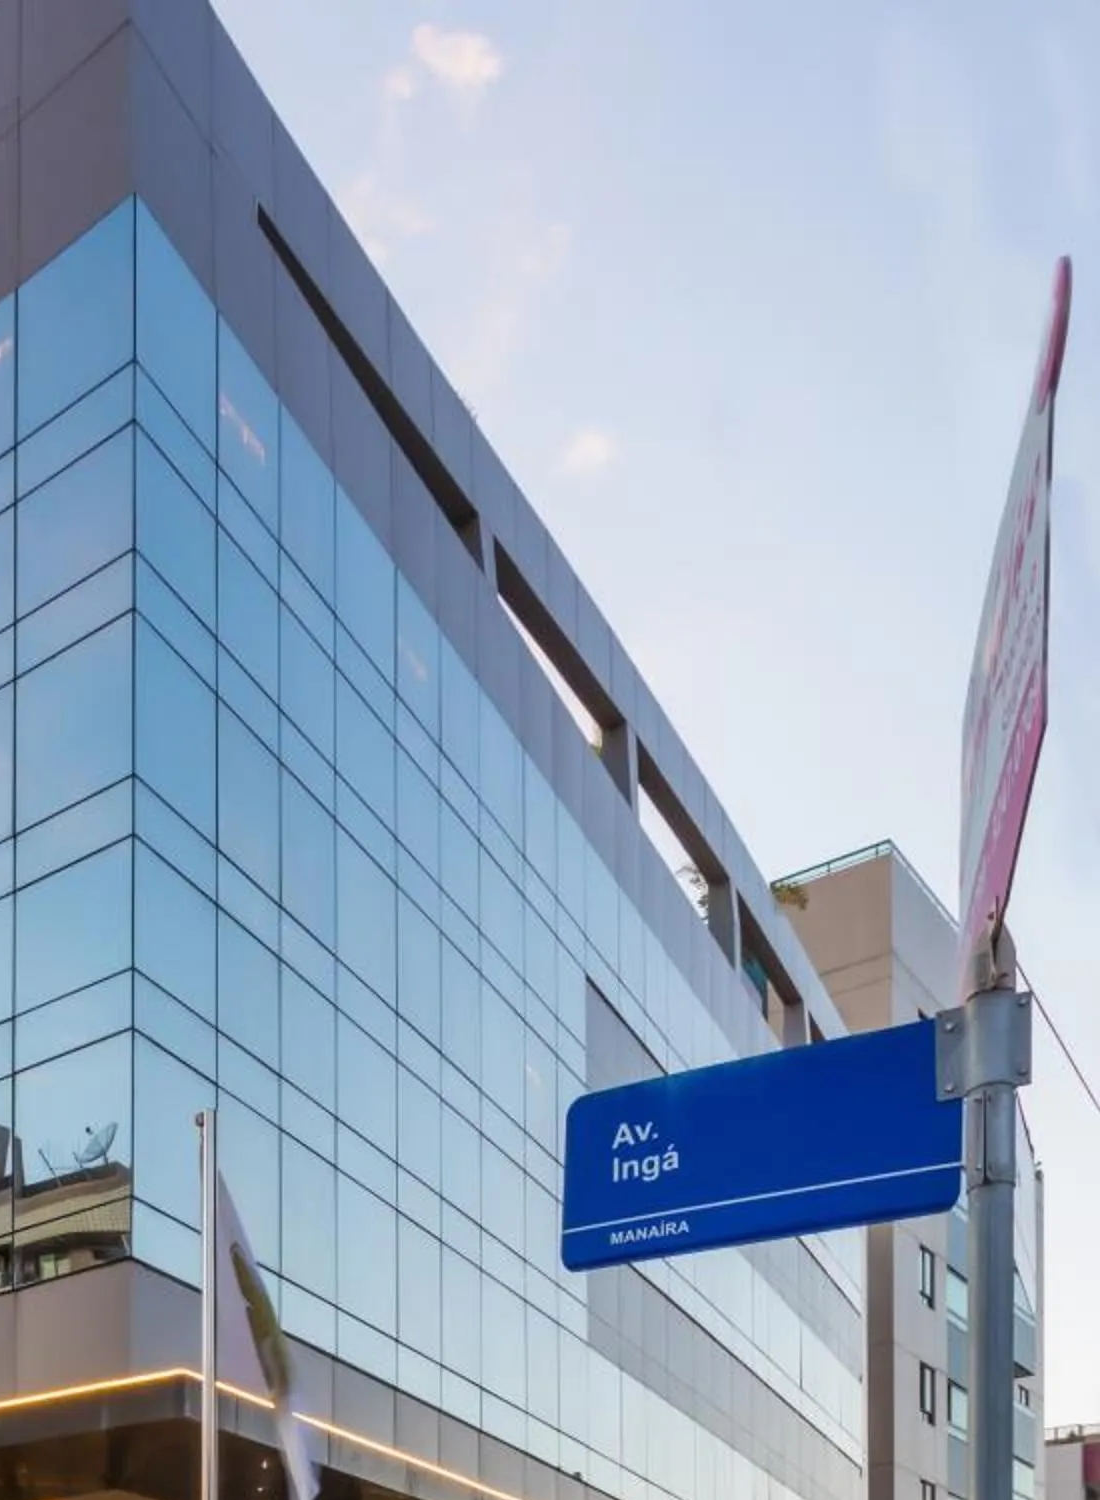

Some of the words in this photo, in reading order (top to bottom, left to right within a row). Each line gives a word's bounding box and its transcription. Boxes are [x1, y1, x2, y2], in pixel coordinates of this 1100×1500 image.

[612, 1121, 659, 1149] Av.
[612, 1143, 679, 1183] Ingá
[609, 1220, 690, 1246] MANAÍRA
